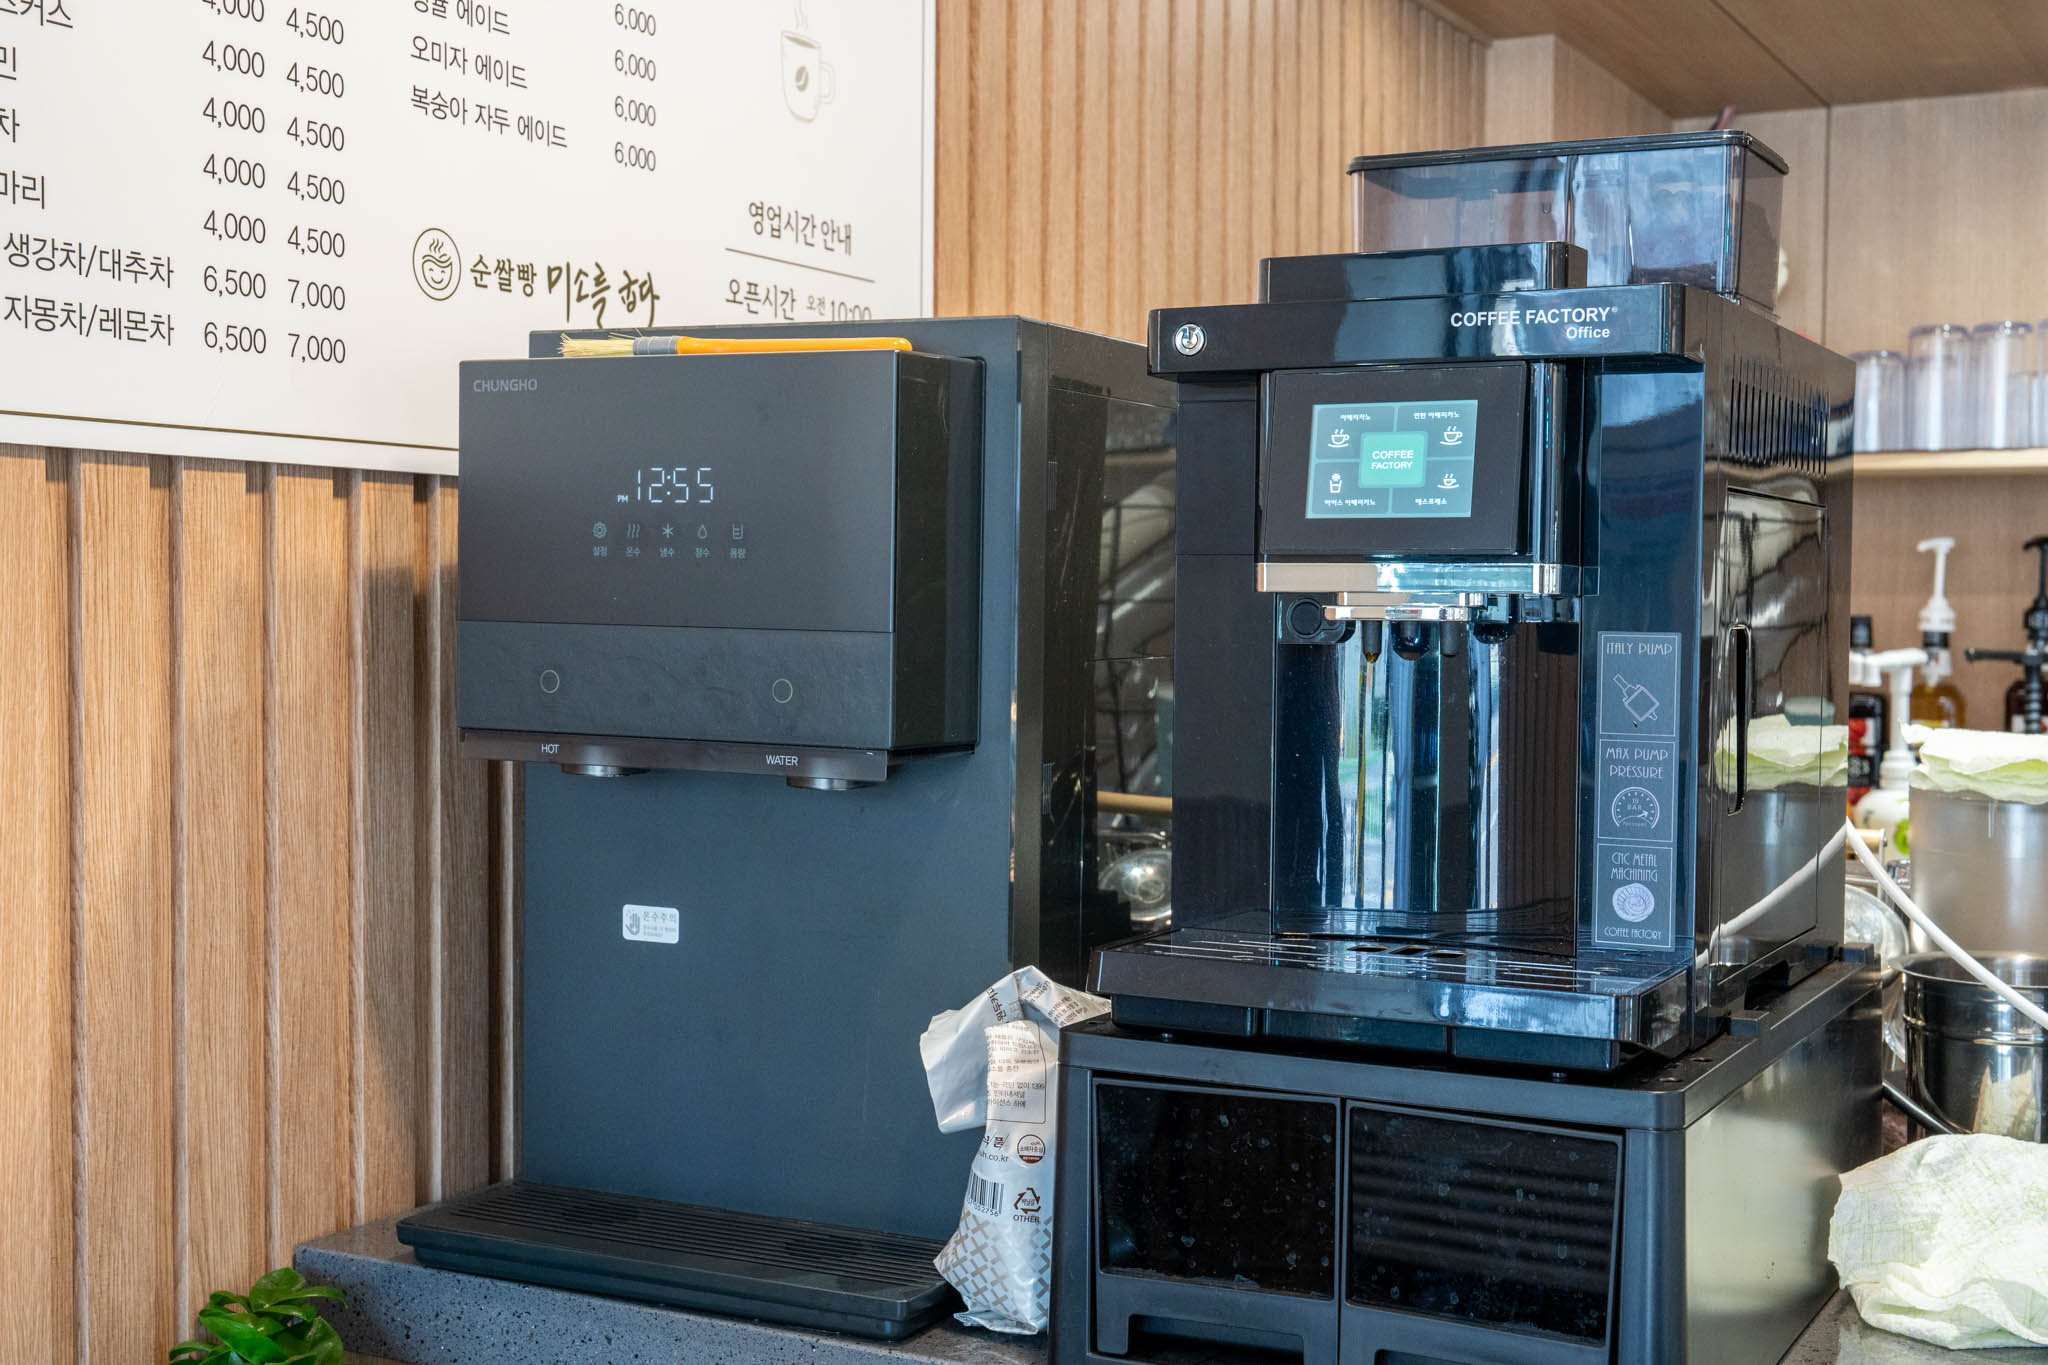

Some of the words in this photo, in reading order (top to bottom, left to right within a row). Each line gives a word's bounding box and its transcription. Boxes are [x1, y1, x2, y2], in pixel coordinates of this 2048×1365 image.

[286, 8, 344, 45] 4,500
[615, 3, 656, 36] 6,000
[457, 0, 510, 35] 에이드
[615, 49, 656, 81] 6,000
[202, 40, 265, 78] 4,000
[286, 62, 344, 98] 4,500
[410, 36, 468, 75] 오미자
[475, 55, 527, 88] 에이드
[615, 96, 656, 126] 6,000
[203, 97, 265, 133] 4,000
[287, 117, 344, 151] 4,500
[411, 85, 468, 125] 복숭아
[475, 104, 510, 135] 자두
[517, 116, 567, 148] 에이드
[615, 141, 656, 171] 6,000
[203, 154, 265, 189] 4,000
[287, 171, 345, 205] 4,500
[203, 210, 266, 244] 4,000
[288, 225, 345, 258] 4,500
[749, 201, 816, 247] 영업시간
[821, 220, 851, 256] 안내
[3, 232, 174, 288] 생강차/대추차
[204, 266, 266, 299] 6,500
[288, 279, 345, 311] 7,000
[470, 254, 537, 297] 순쌀빵
[726, 279, 796, 320] 오픈시간
[4, 295, 174, 346] 자몽차/레몬차
[204, 322, 266, 354] 6,500
[288, 333, 345, 364] 7,000
[1450, 311, 1520, 327] COFFEE
[1566, 326, 1610, 340] Office
[473, 379, 538, 393] CHUNGHO
[1371, 462, 1413, 470] FACTORY
[1372, 450, 1414, 460] COFFEE
[636, 467, 714, 504] 12:55
[1606, 642, 1633, 655] ITALY
[1639, 643, 1673, 656] PUMP
[541, 744, 560, 754] HOT
[765, 754, 799, 767] WATER
[1606, 748, 1631, 760] MAX
[1635, 748, 1669, 761] PUMP
[1609, 765, 1664, 779] PRESSURE
[1610, 867, 1658, 882] MACHINING
[1612, 852, 1631, 865] CNC
[1633, 853, 1658, 867] METAL
[1604, 926, 1630, 938] COFFEE
[1632, 928, 1662, 940] FACTORY
[1012, 1214, 1040, 1223] OTHER
